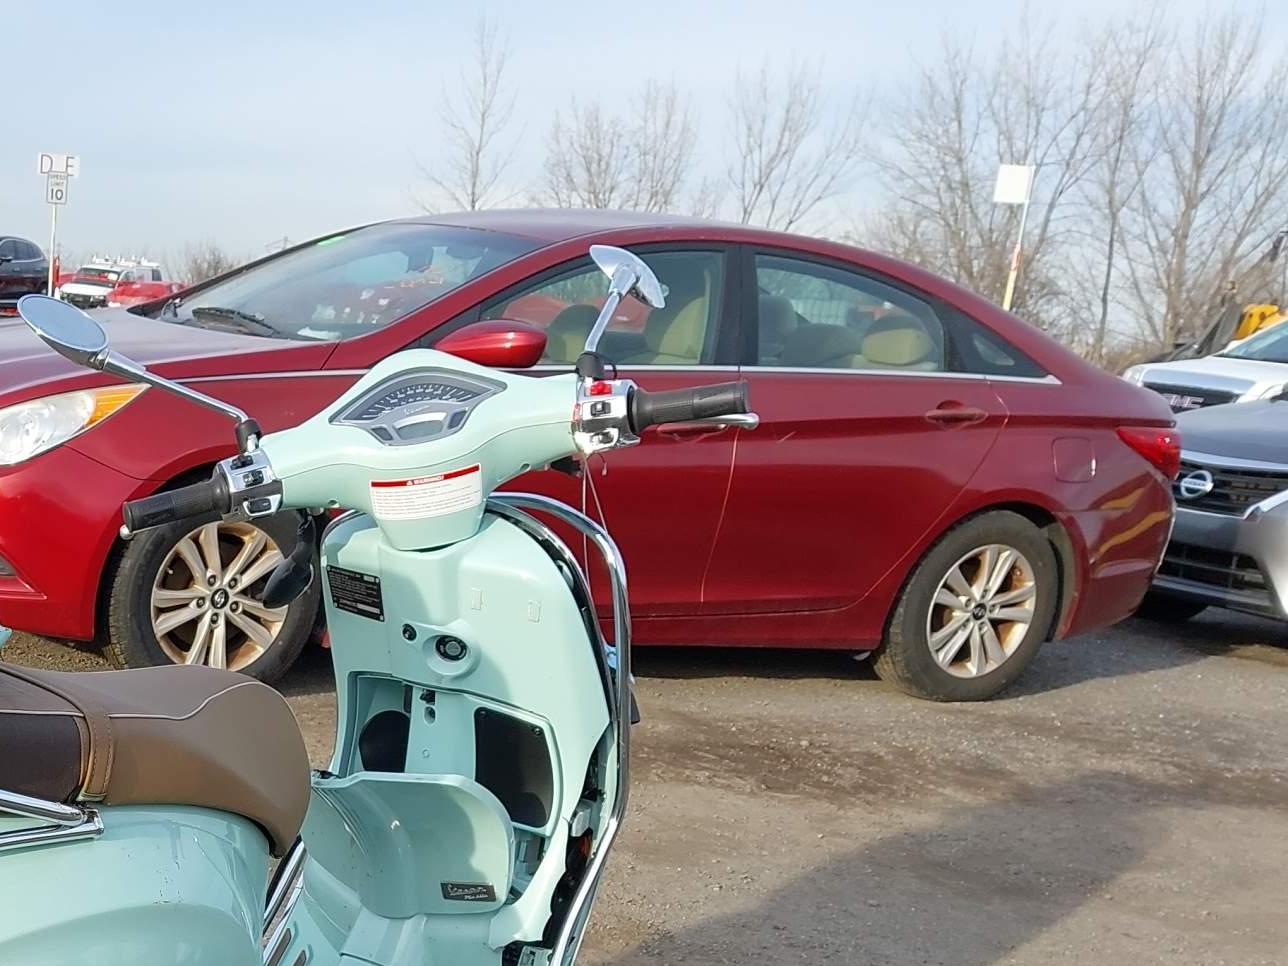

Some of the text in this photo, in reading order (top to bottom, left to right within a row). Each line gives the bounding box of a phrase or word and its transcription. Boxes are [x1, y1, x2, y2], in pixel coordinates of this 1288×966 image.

[40, 153, 76, 177] D E
[50, 188, 64, 201] 10
[1163, 393, 1205, 409] MC
